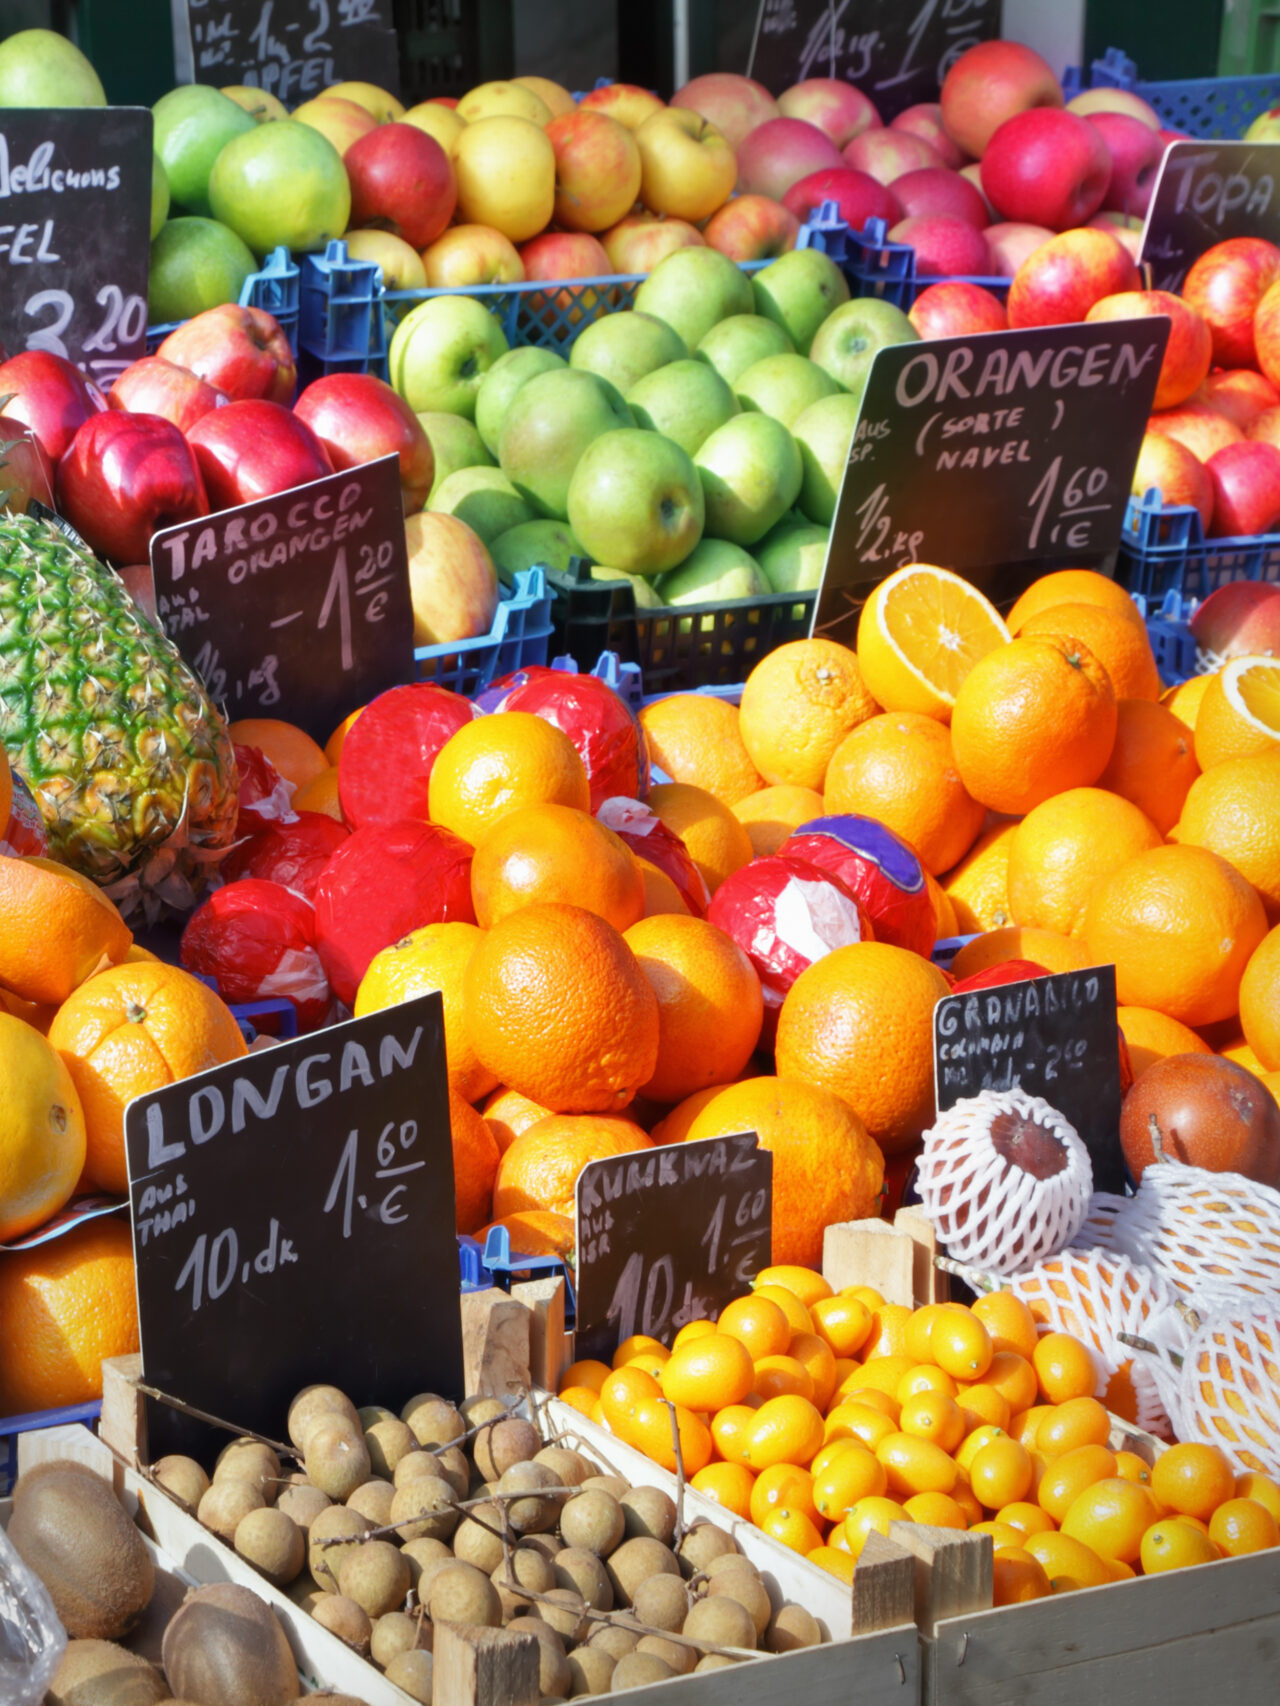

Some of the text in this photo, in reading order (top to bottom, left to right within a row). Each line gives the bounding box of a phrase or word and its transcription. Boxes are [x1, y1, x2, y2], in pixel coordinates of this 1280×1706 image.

[241, 58, 343, 100] ÄPFEL
[1169, 152, 1277, 226] TOPA
[895, 343, 1158, 408] ORANGEN
[854, 418, 891, 444] AUS
[935, 440, 1031, 472] NAVEL
[162, 482, 362, 582] TAROCCO
[227, 507, 373, 585] ORANGEN
[146, 1026, 424, 1170] LONGAN
[138, 1173, 188, 1216] AUS
[136, 1199, 196, 1247] THAI
